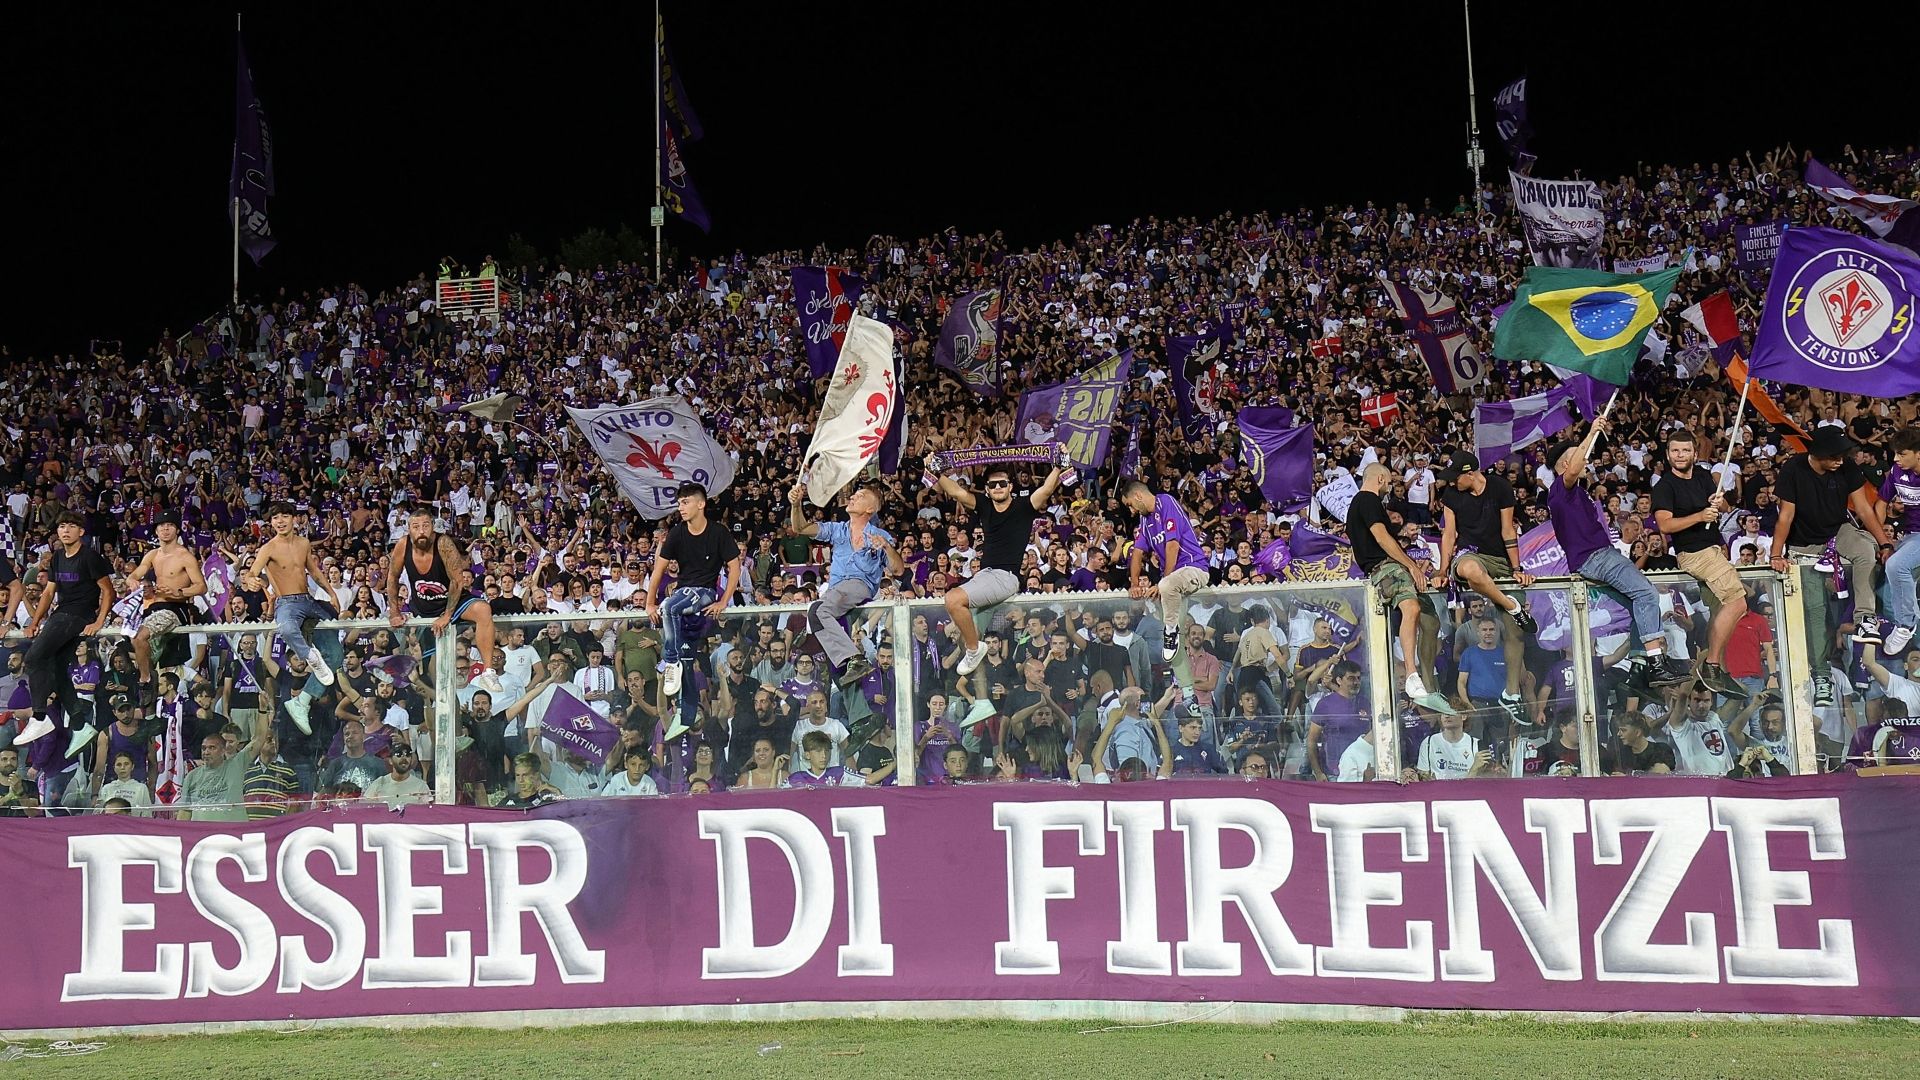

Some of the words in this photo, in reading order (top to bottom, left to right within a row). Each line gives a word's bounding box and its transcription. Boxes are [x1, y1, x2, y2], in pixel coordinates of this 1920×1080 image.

[1742, 238, 1768, 250] MORTE
[1770, 234, 1783, 247] NO
[1746, 251, 1755, 262] CI
[1837, 254, 1877, 274] ALTA
[1454, 340, 1479, 380] 6
[1801, 335, 1880, 365] TENSIONE
[652, 468, 709, 506] 199
[60, 819, 606, 1002] ESSER
[698, 806, 894, 980] DI
[993, 797, 1859, 986] FIRENZE
